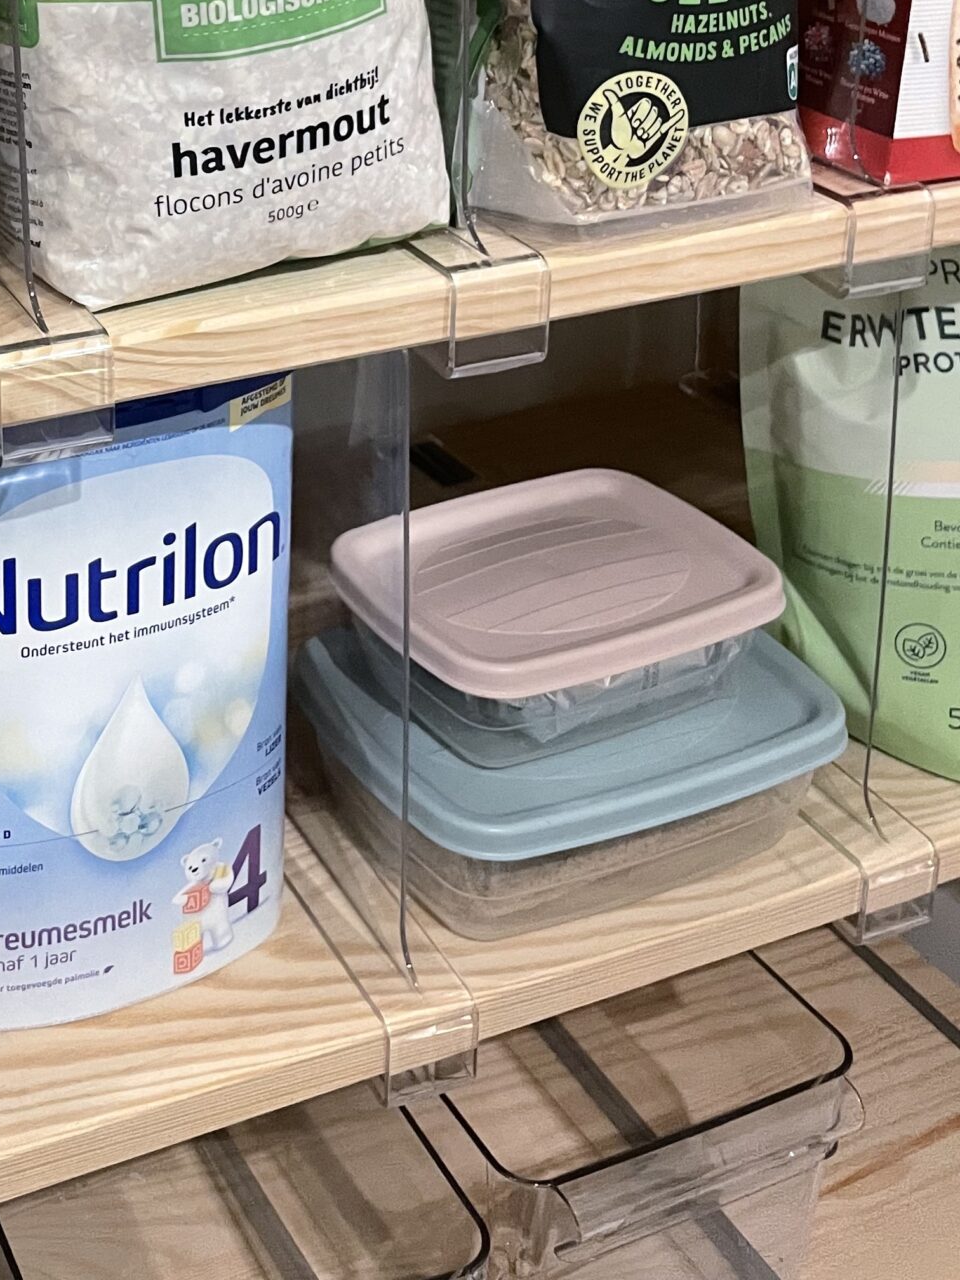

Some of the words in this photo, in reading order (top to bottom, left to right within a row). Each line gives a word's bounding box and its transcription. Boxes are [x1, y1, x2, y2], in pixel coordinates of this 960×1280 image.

[618, 35, 717, 62] ALMONDS
[721, 39, 735, 58] &
[739, 13, 792, 55] PECANS
[615, 74, 682, 110] TOGETHER
[183, 110, 215, 127] Het
[219, 98, 293, 126] lekkerste
[296, 93, 322, 109] van
[584, 102, 603, 123] WE
[171, 93, 392, 179] havermout
[648, 126, 685, 174] PLANET
[582, 128, 622, 182] SUPPORT
[153, 186, 245, 218] flocons
[251, 160, 344, 200] d'avoine
[349, 135, 406, 178] petits
[624, 167, 646, 183] THE
[267, 202, 305, 224] 500g
[20, 636, 105, 658] Ondersteunt
[109, 629, 130, 644] het
[3, 830, 11, 839] D
[228, 824, 267, 914] 4
[29, 955, 38, 968] 1
[43, 949, 77, 969] jaar
[6, 976, 63, 992] toegevoegde
